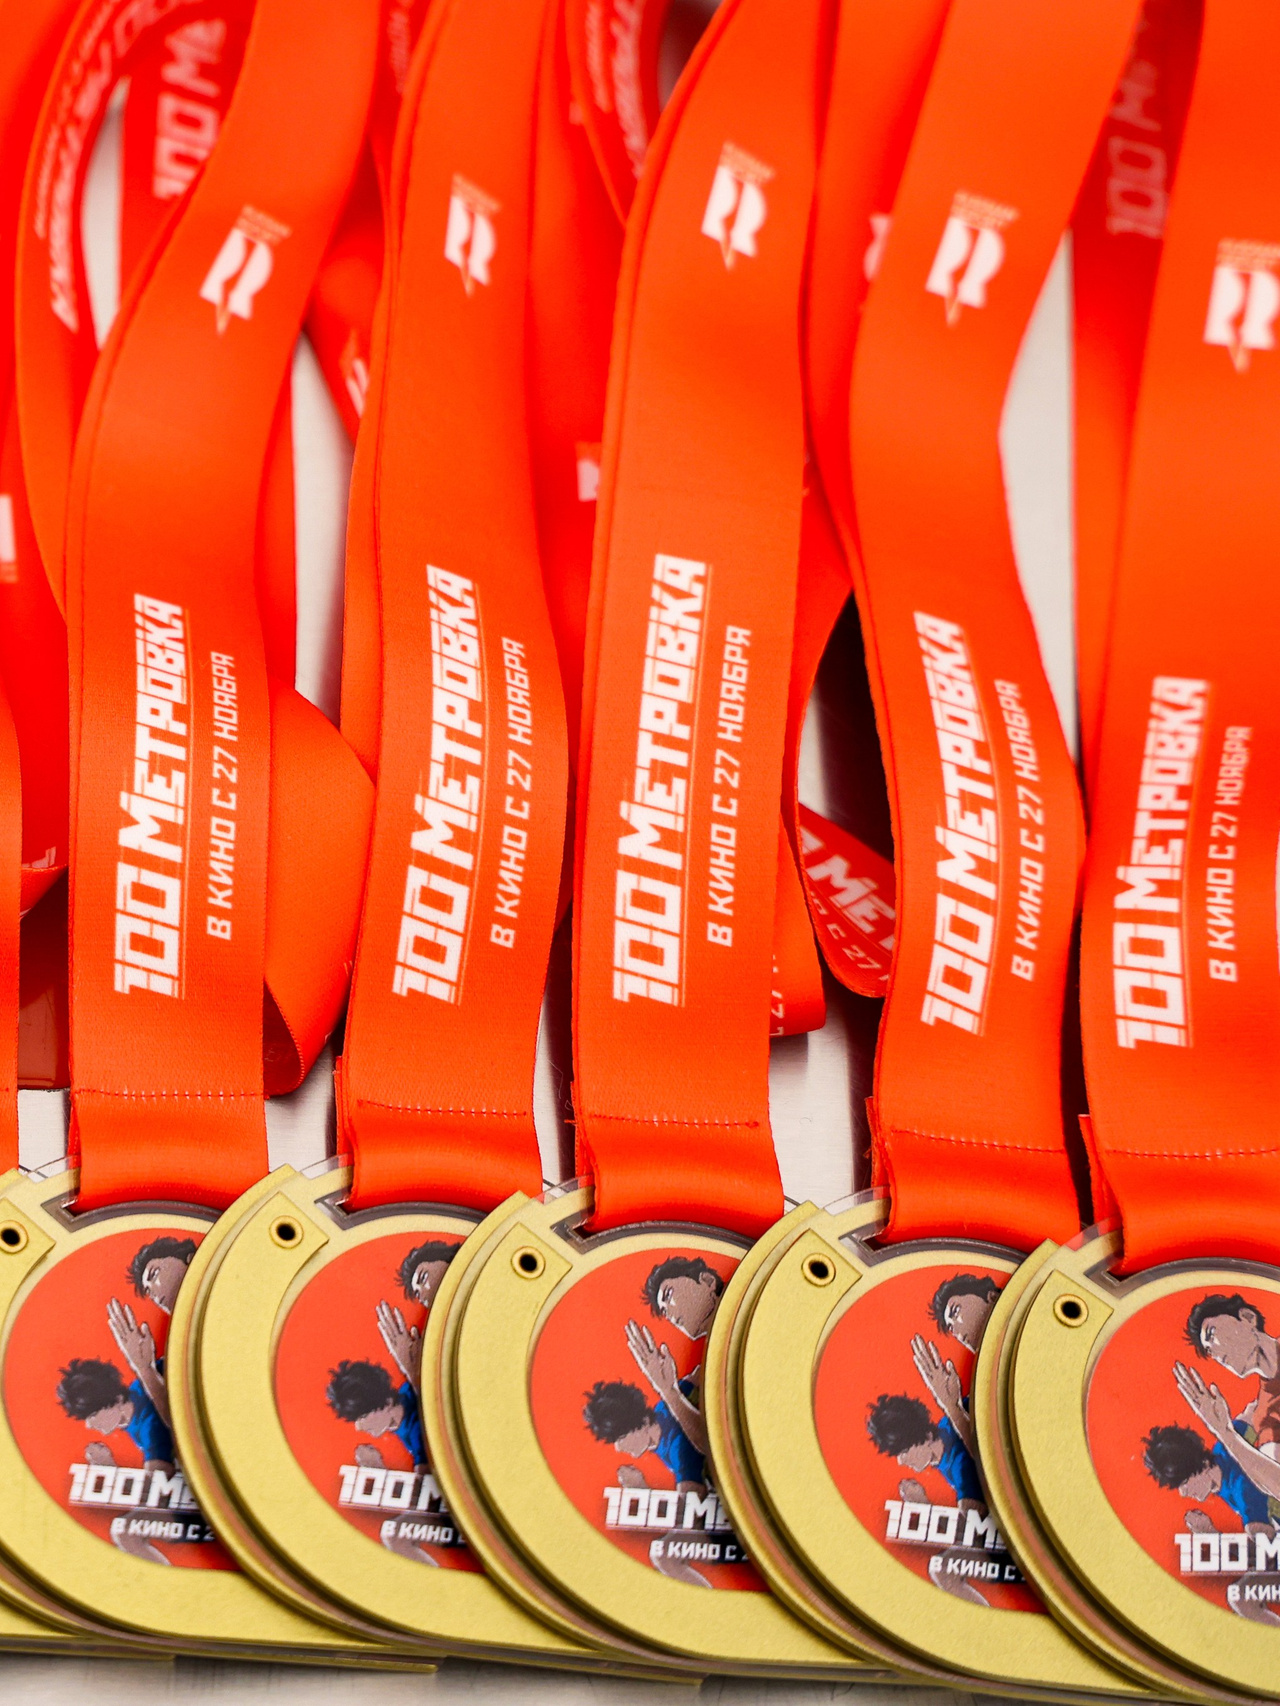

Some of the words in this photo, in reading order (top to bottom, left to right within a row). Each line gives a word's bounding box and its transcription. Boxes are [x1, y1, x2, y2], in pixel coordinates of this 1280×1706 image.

[210, 651, 238, 742] НОЯБРЯ
[501, 637, 533, 746] НОЯБРЯ
[716, 624, 752, 743] НОЯБРЯ
[993, 679, 1040, 782] НОЯБРЯ
[211, 745, 238, 784] 27
[506, 748, 532, 792] 27
[713, 748, 741, 789] 27
[1214, 726, 1251, 805] НОЯБРЯ
[211, 787, 237, 811] С
[504, 794, 531, 820] С
[711, 793, 739, 817] С
[1016, 784, 1044, 826] 27
[1019, 827, 1045, 853] С
[1210, 811, 1236, 838] 27
[207, 815, 237, 910] КИНО
[494, 824, 528, 918] КИНО
[707, 822, 737, 916] КИНО
[1208, 844, 1235, 860] С
[1015, 856, 1044, 950] КИНО
[1206, 867, 1235, 951] КИНО
[114, 862, 181, 997] 100
[206, 915, 232, 941] В
[393, 866, 470, 1003] 100
[490, 923, 515, 949] В
[613, 871, 682, 1005] 100
[706, 921, 733, 947] В
[921, 893, 995, 1034] 100
[1011, 954, 1035, 981] В
[1209, 958, 1237, 982] В
[1113, 922, 1185, 1049] 100
[70, 1463, 145, 1505] 100
[339, 1465, 417, 1508] 100
[111, 1518, 125, 1533] В
[128, 1519, 183, 1537] КИНО
[187, 1524, 199, 1538] С
[603, 1487, 679, 1528] 100
[885, 1500, 959, 1544] 100
[381, 1521, 396, 1536] В
[399, 1524, 453, 1541] КИНО
[650, 1540, 664, 1556] В
[667, 1542, 720, 1560] КИНО
[725, 1545, 737, 1560] С
[929, 1556, 943, 1571] В
[947, 1559, 999, 1577] КИНО
[1004, 1565, 1015, 1579] С
[1174, 1533, 1248, 1571] 100
[1228, 1585, 1240, 1601] В
[1245, 1585, 1280, 1601] КИН
